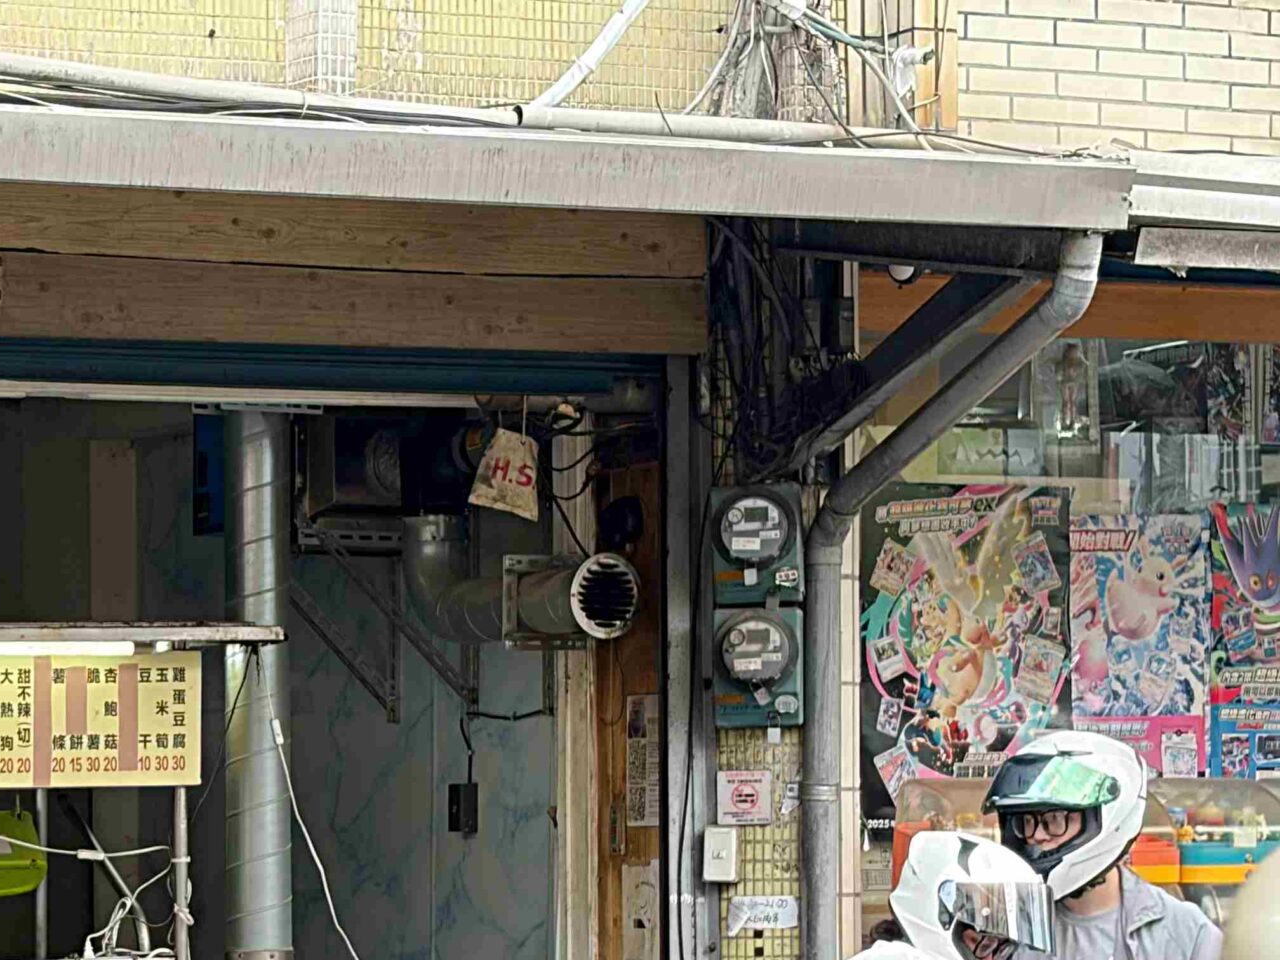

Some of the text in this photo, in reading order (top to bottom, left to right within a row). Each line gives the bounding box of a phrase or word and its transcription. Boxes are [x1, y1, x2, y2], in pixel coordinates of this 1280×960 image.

[0, 668, 14, 773] 大熱狗 20
[17, 668, 32, 773] 甜不辣(切) 20
[52, 668, 66, 772] 薯條 20
[69, 757, 82, 772] 15
[86, 668, 100, 772] 脆薯 30
[103, 668, 118, 772] 杏鮑菇 20
[138, 668, 152, 771] 豆干 10
[154, 667, 169, 771] 玉米筍 30
[172, 667, 186, 771] 雞蛋豆腐 30
